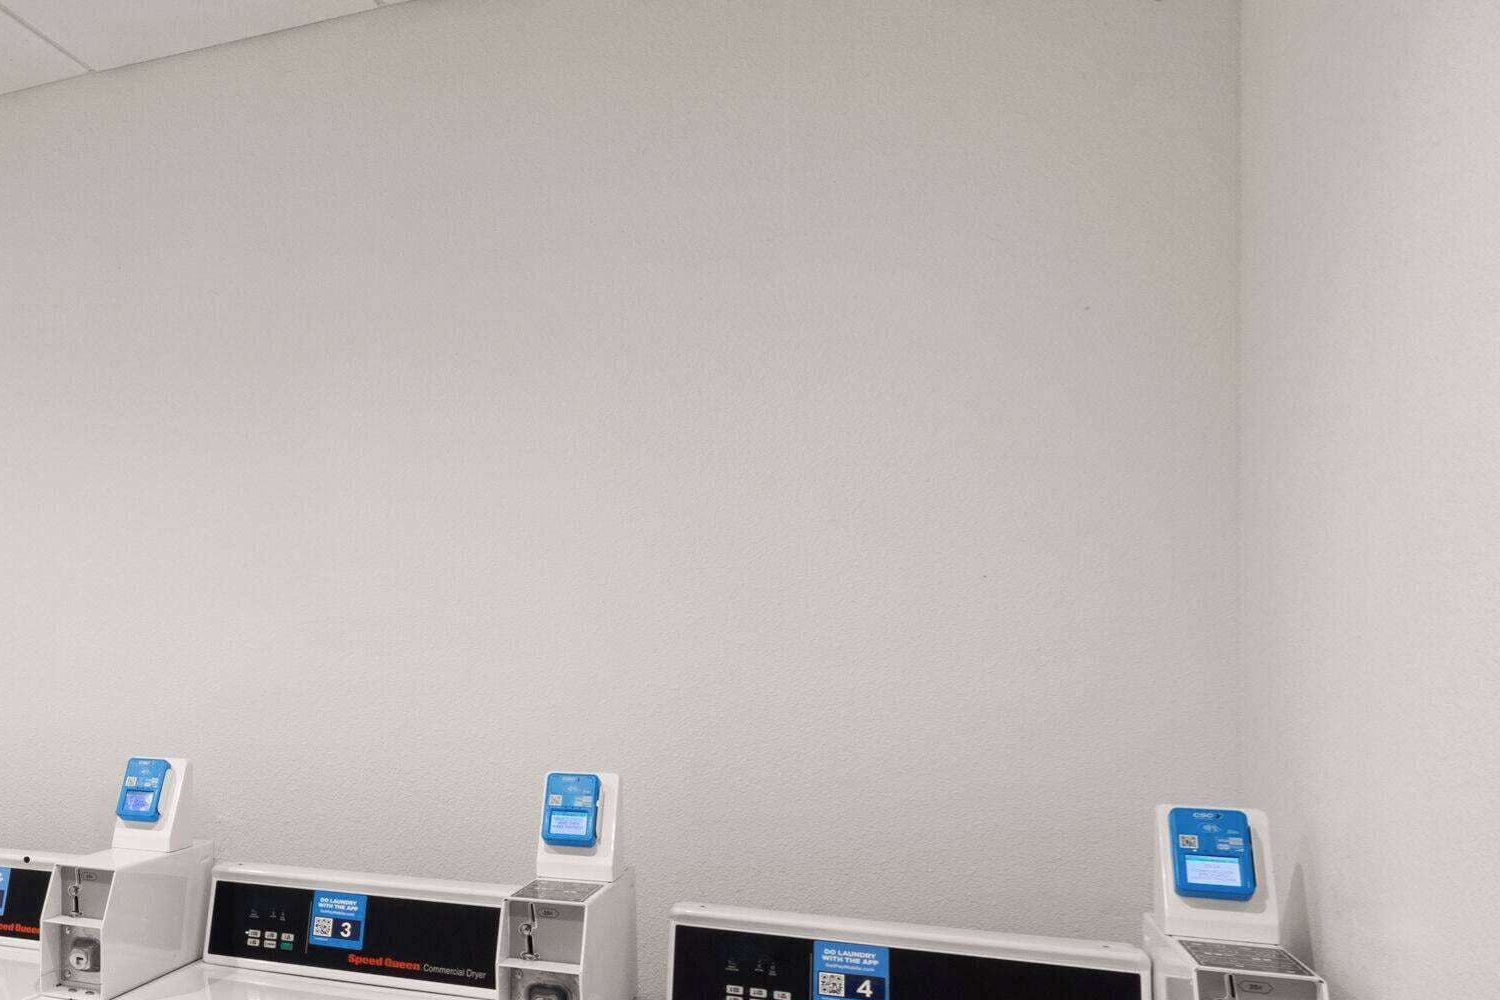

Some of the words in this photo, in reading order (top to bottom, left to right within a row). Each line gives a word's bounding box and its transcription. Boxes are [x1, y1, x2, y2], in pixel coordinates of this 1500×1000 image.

[340, 921, 352, 938] 3
[821, 954, 844, 963] WITH
[844, 957, 861, 965] THE
[862, 959, 879, 967] APP
[823, 948, 836, 956] DO
[837, 950, 876, 960] LAUNDRY
[348, 953, 383, 967] Speed
[384, 957, 421, 971] Queen
[423, 962, 466, 977] Commercial
[466, 968, 487, 980] Dryer
[856, 979, 874, 998] 4
